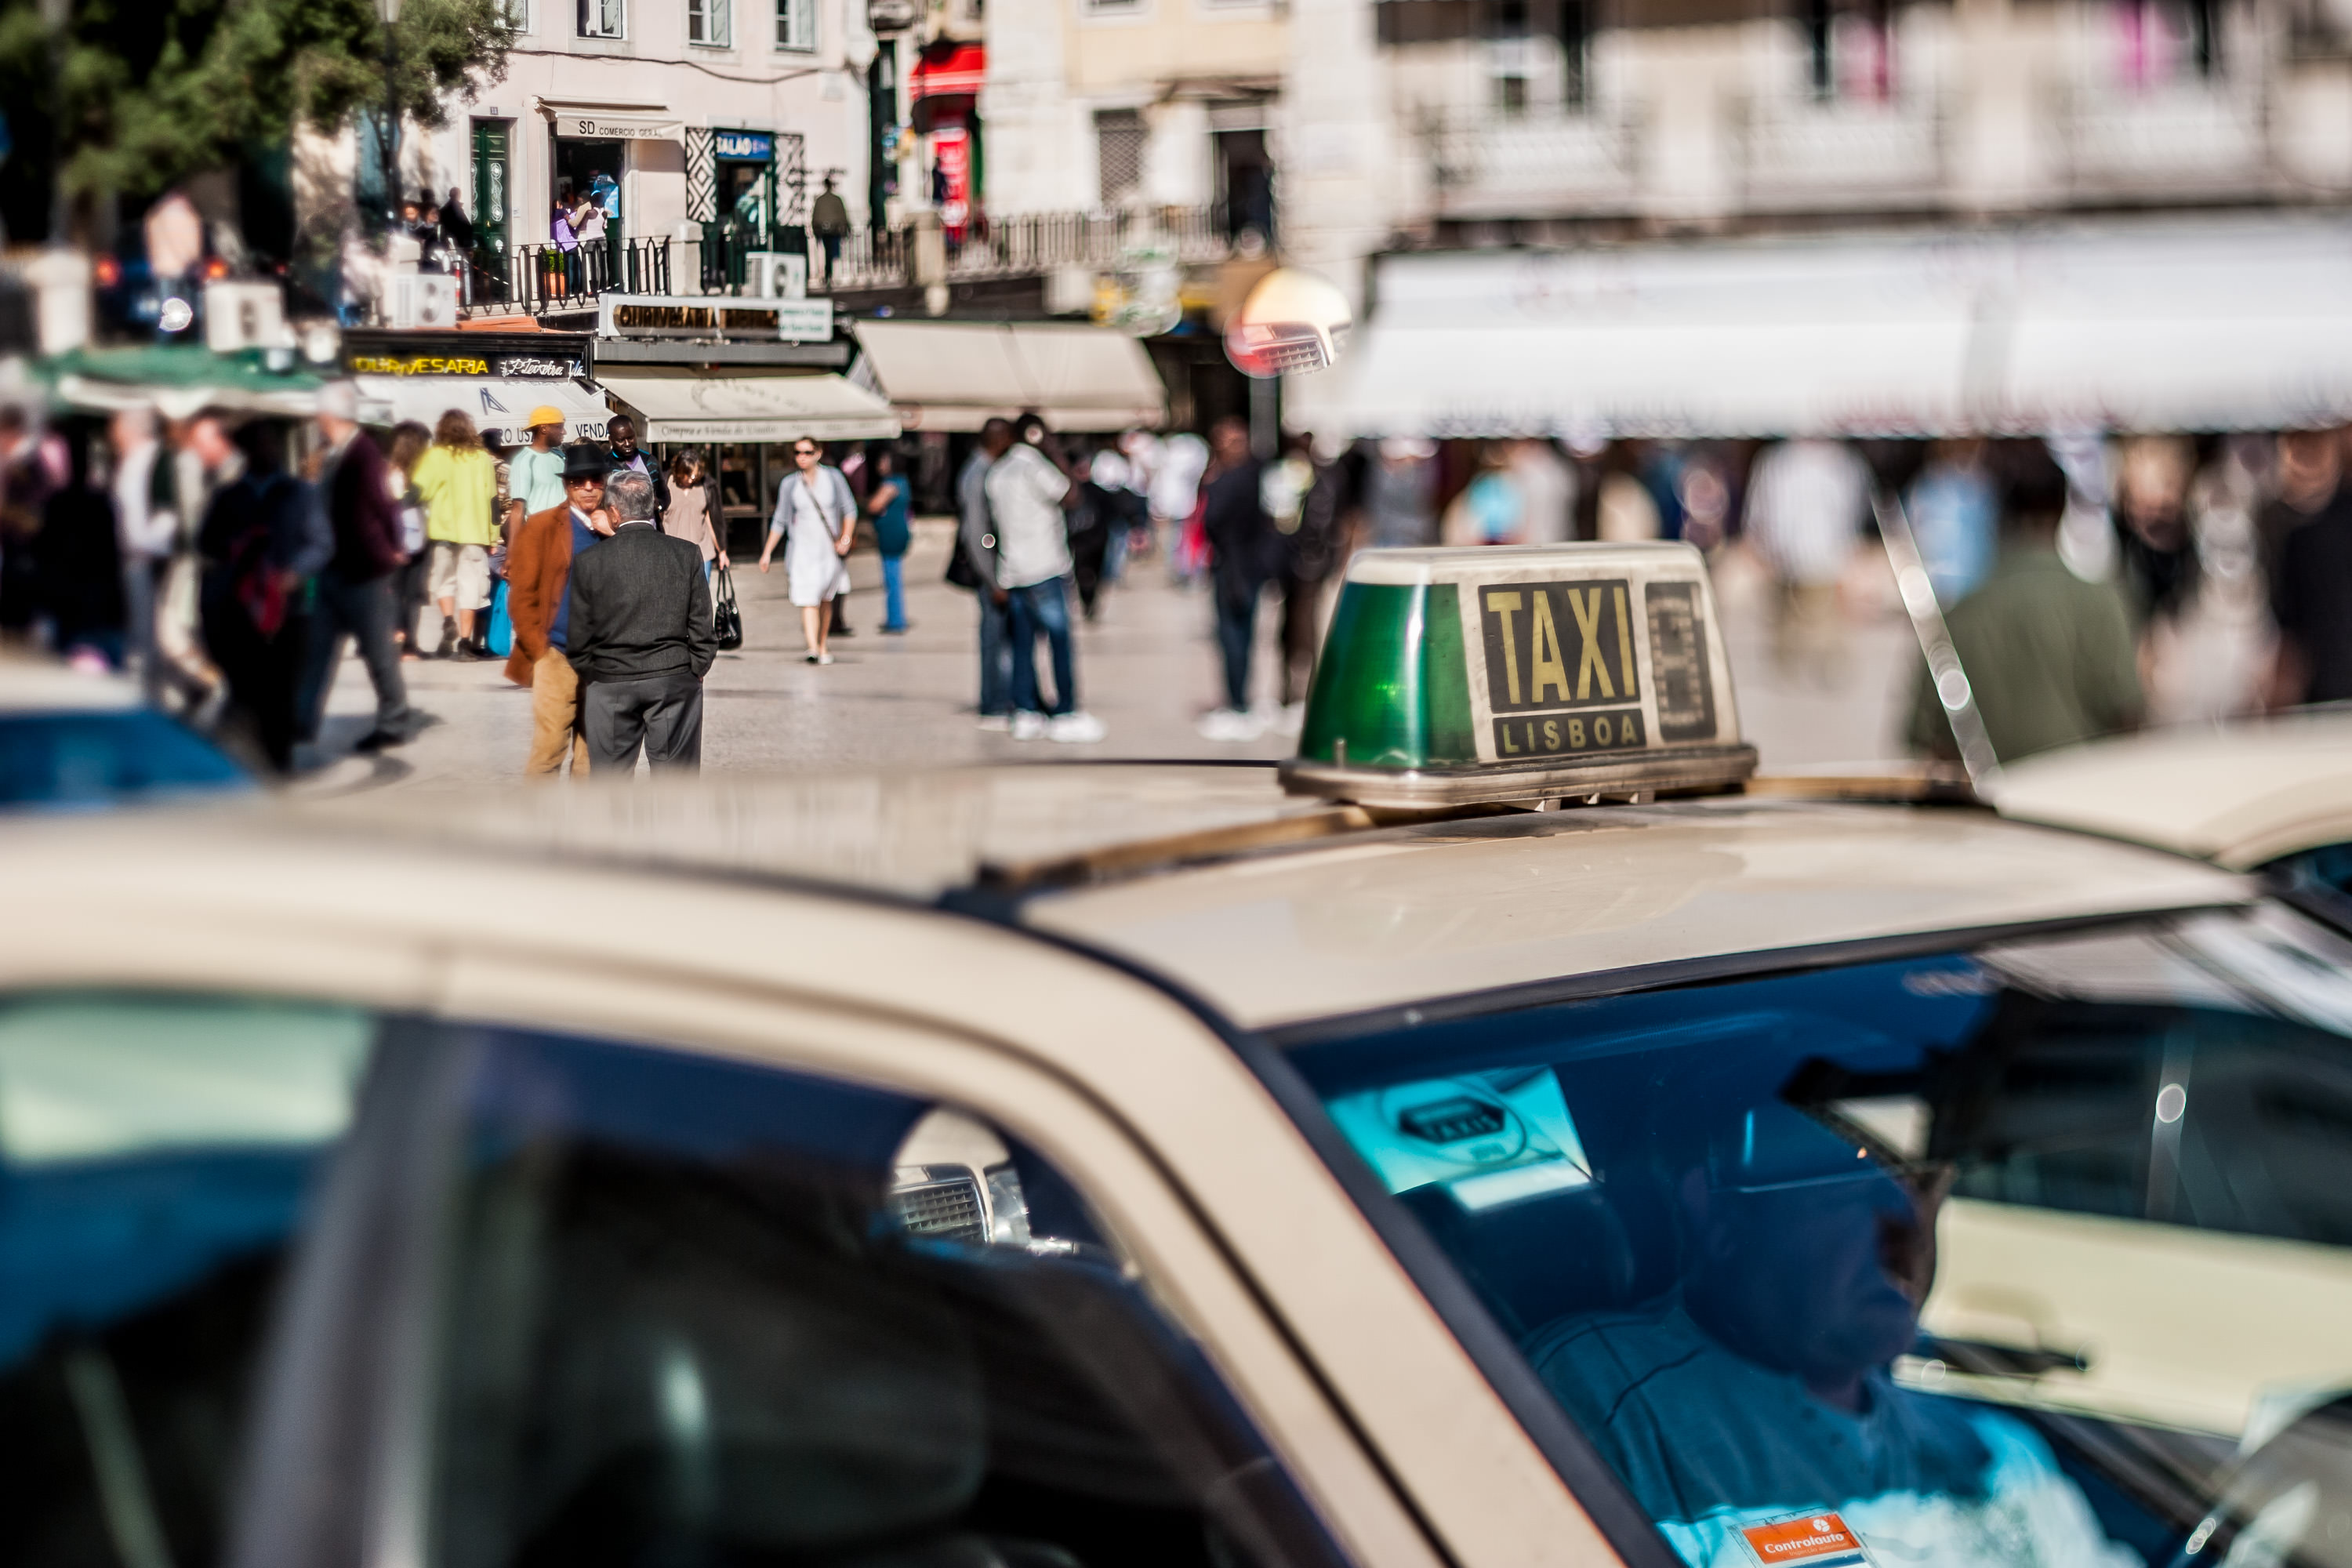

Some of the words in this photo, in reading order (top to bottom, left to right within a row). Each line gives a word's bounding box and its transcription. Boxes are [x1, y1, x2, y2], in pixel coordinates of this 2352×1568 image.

[579, 121, 594, 134] SD
[1486, 586, 1635, 704] TAXI
[1503, 715, 1639, 753] LISBOA
[1764, 1533, 1845, 1554] Controlauto
